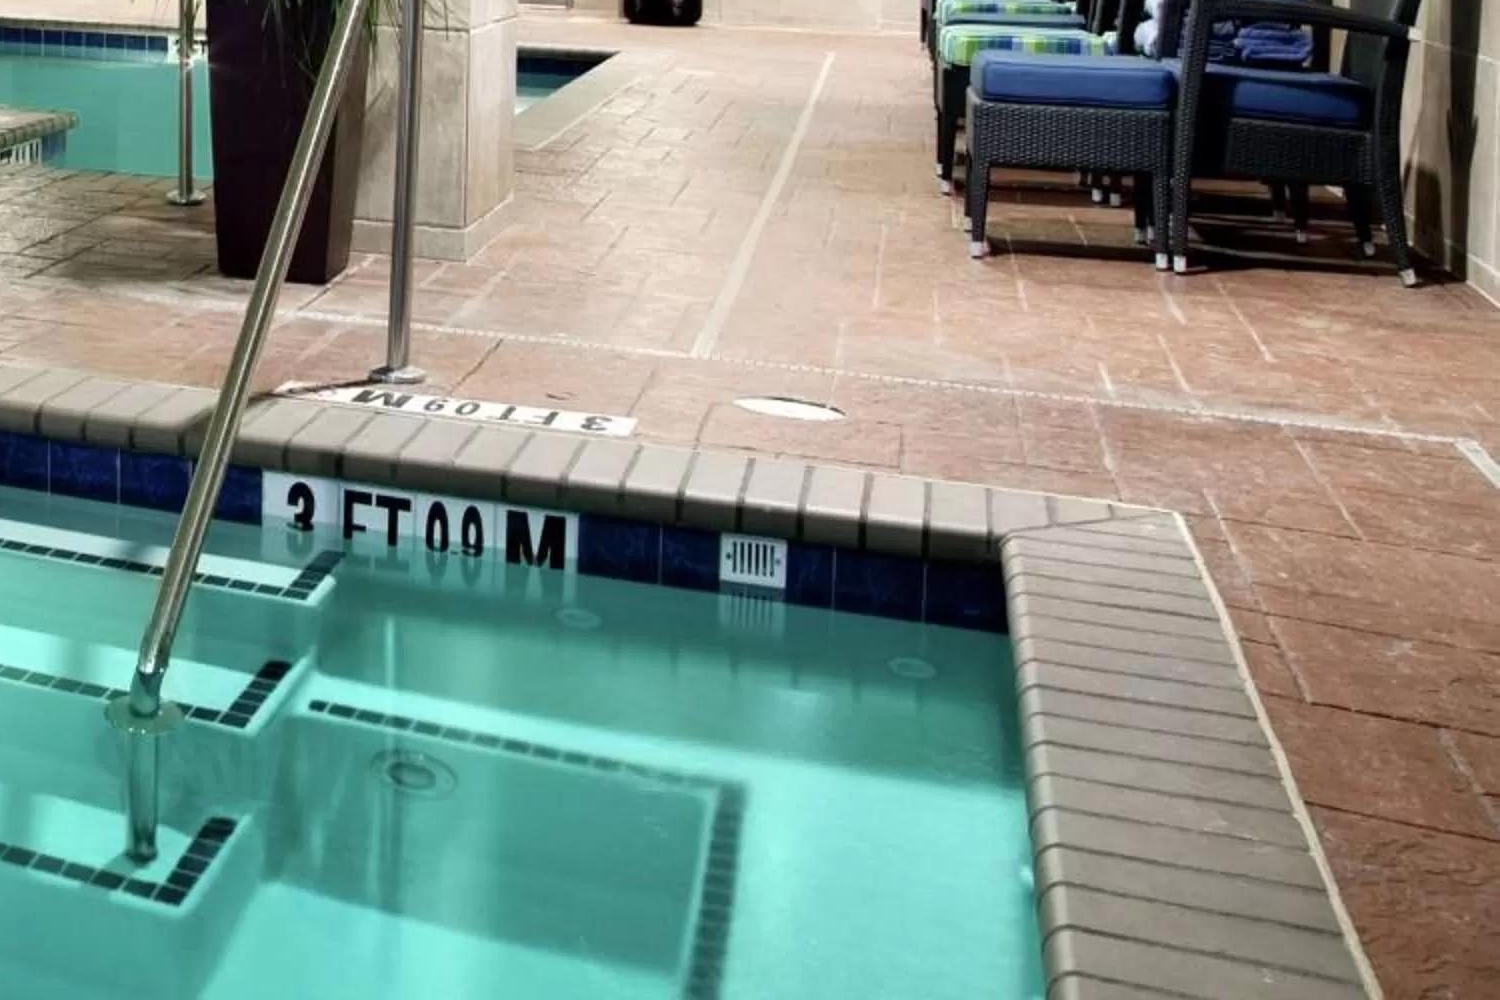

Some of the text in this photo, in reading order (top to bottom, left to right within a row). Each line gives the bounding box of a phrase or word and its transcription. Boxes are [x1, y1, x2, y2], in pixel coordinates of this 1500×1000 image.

[350, 388, 415, 408] M
[580, 415, 613, 431] 3
[287, 481, 315, 532] 3
[343, 489, 412, 547] FT
[506, 510, 567, 570] M
